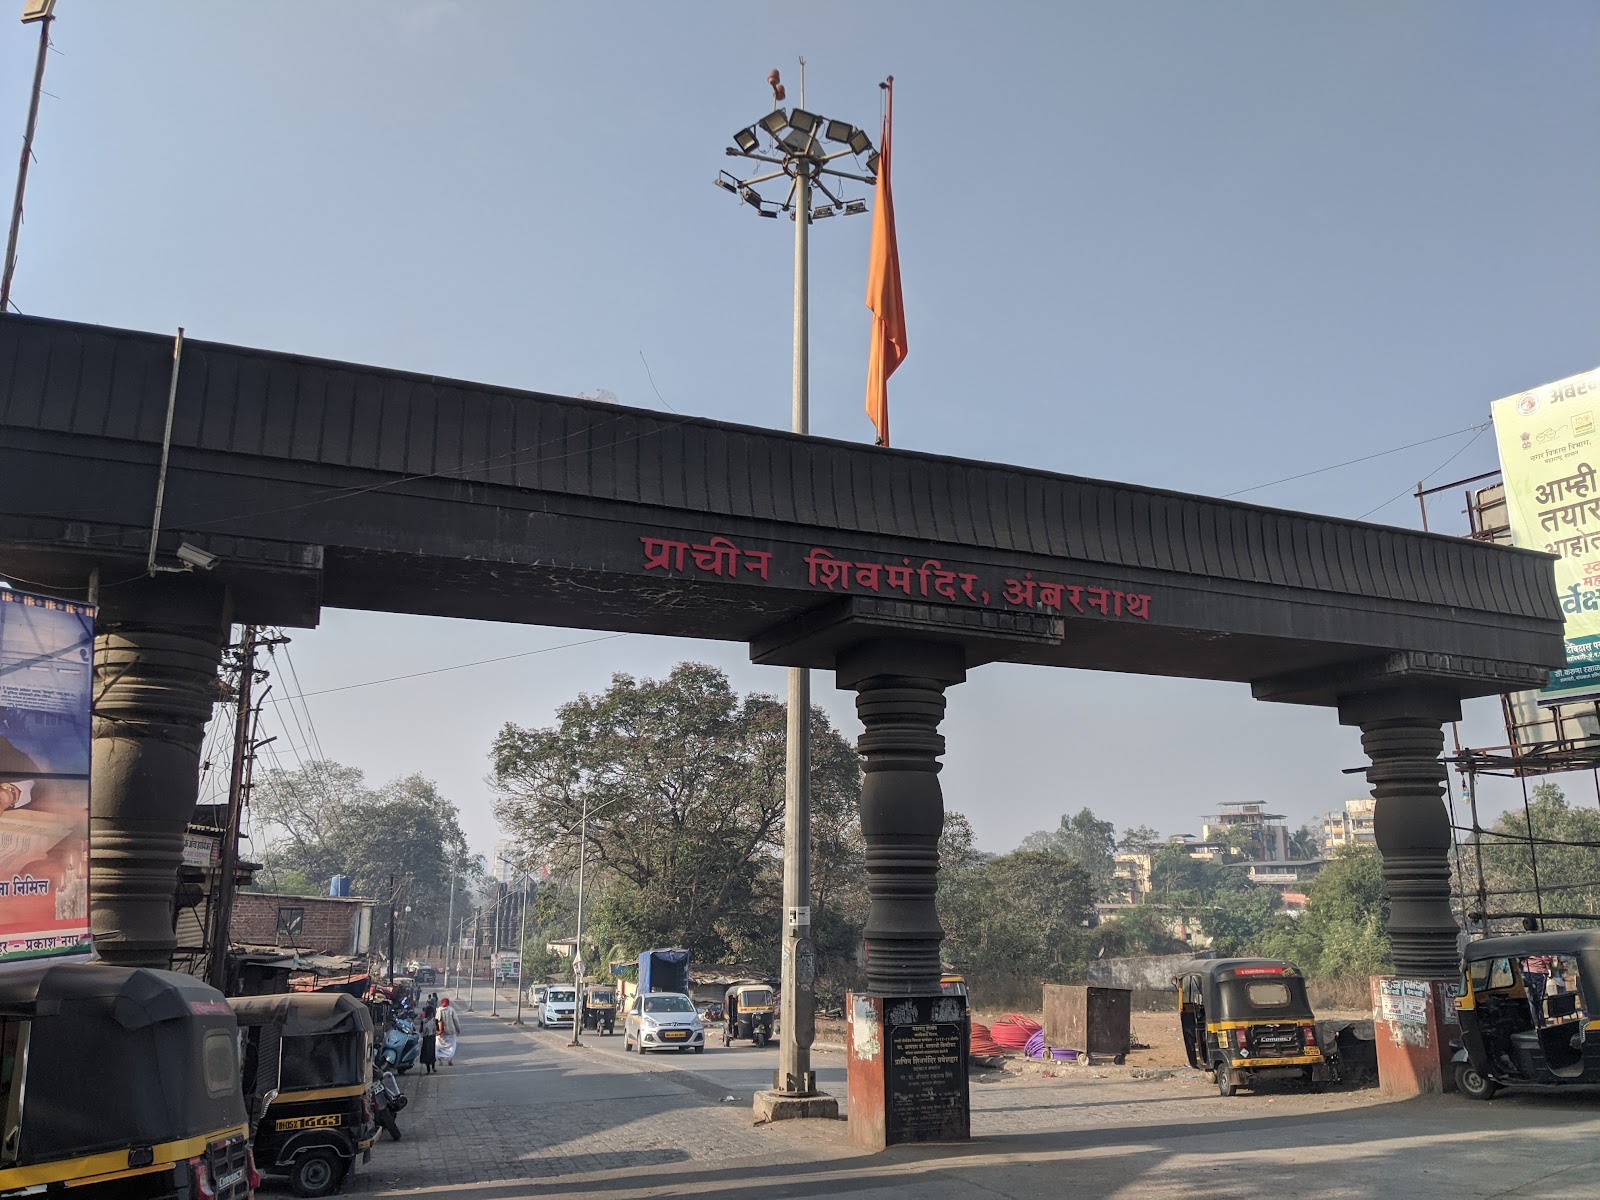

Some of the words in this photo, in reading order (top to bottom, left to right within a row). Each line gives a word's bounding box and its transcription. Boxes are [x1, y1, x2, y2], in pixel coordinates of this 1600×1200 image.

[1535, 462, 1597, 504] आम्ही
[640, 535, 773, 580] प्राचीन
[803, 547, 990, 605] शिवमंदिर,
[1002, 571, 1152, 620] अंबरनाथ
[13, 875, 48, 896] निमित्त
[25, 936, 57, 951] प्रकाश
[60, 934, 79, 947] नगर
